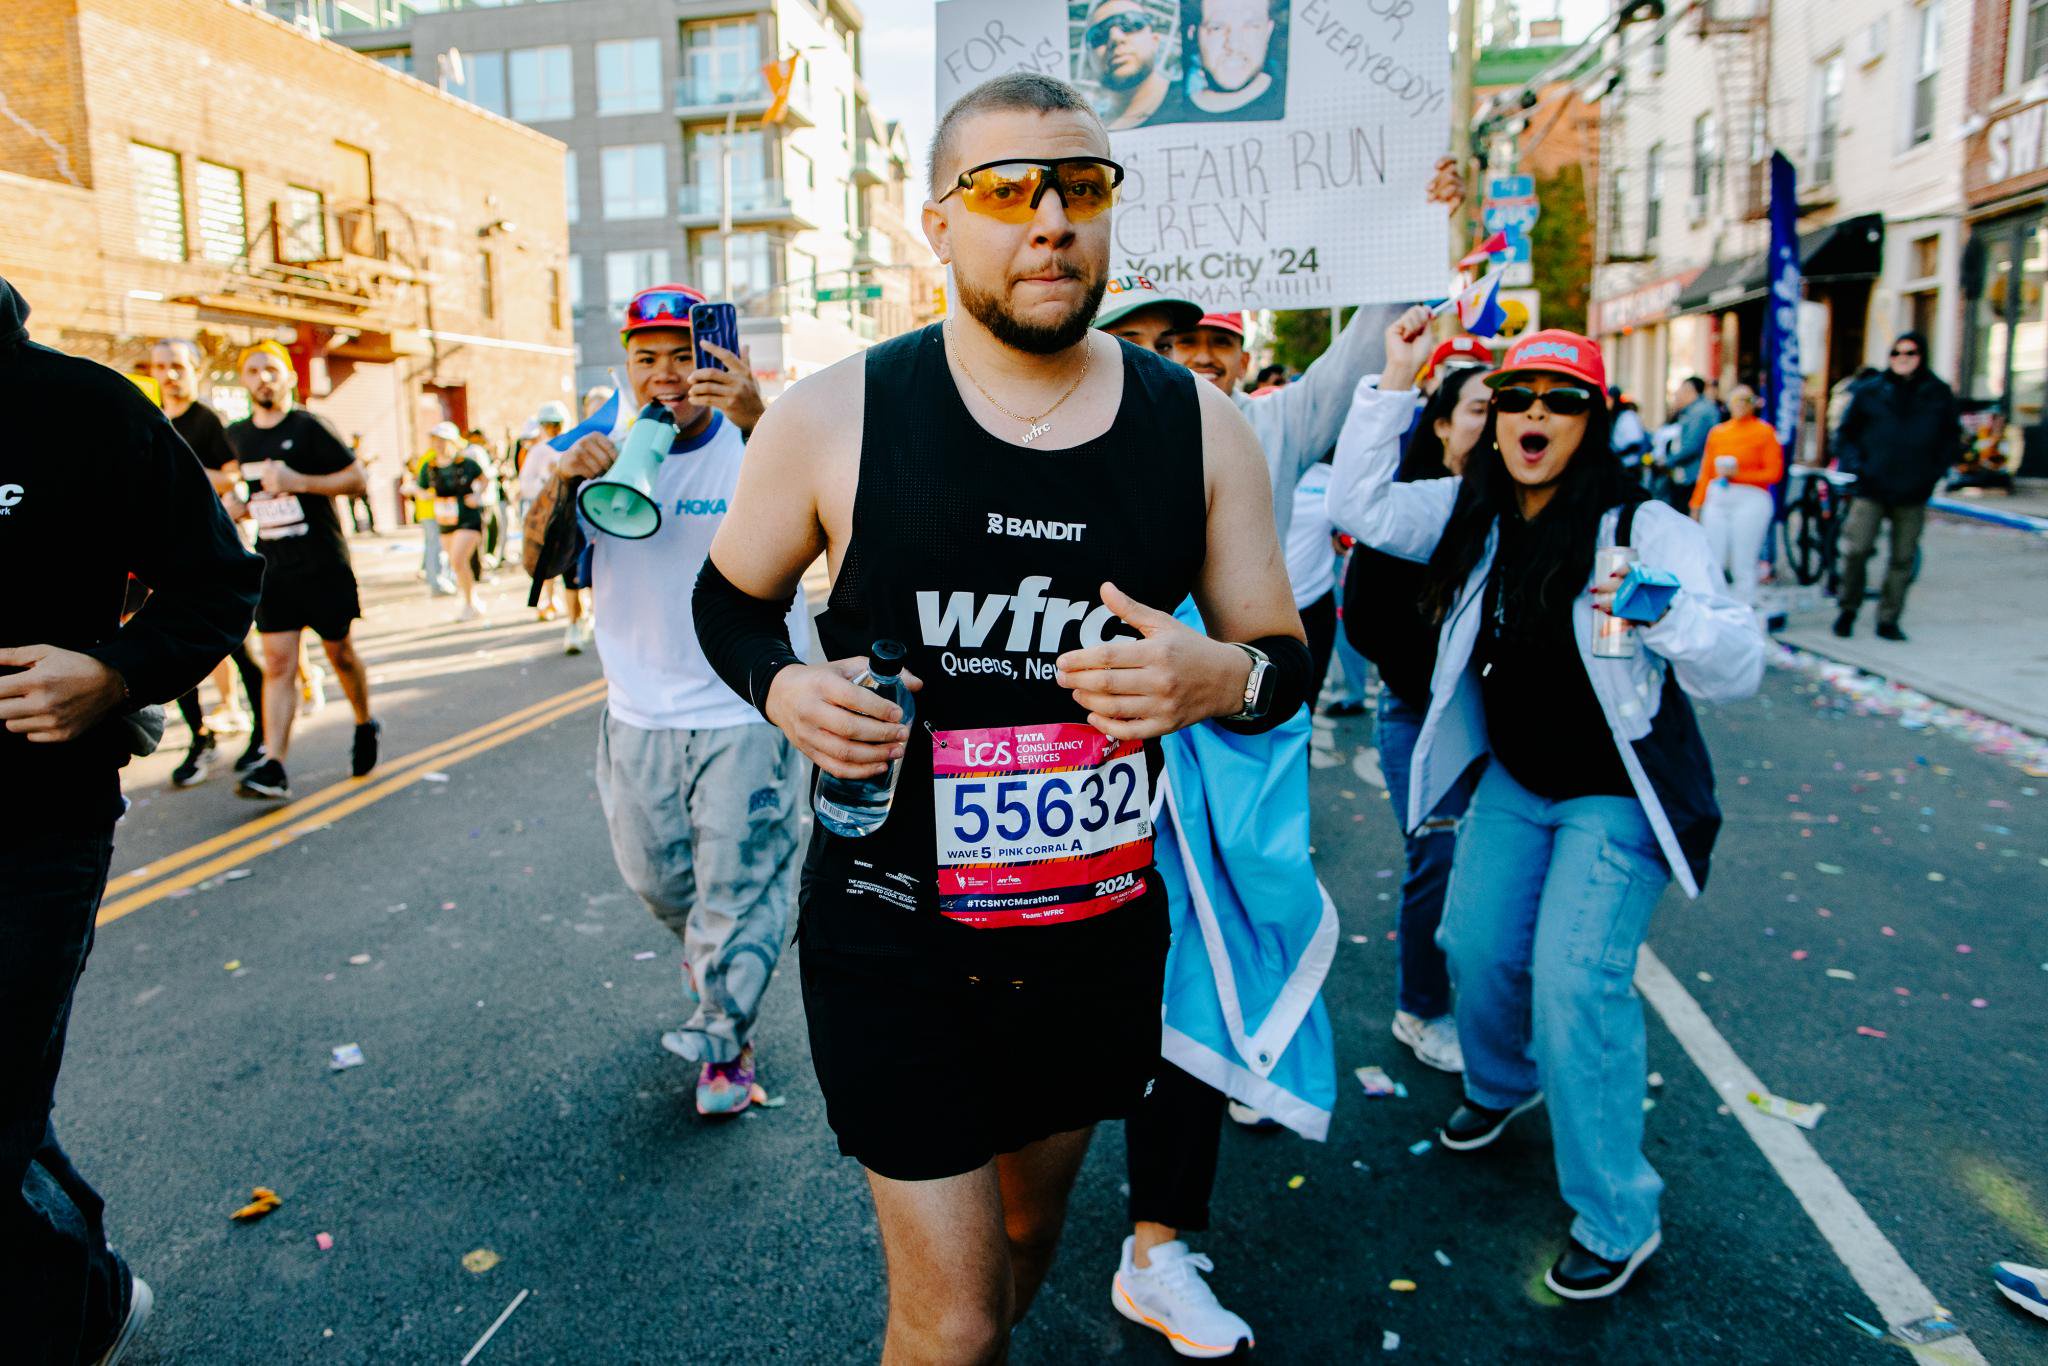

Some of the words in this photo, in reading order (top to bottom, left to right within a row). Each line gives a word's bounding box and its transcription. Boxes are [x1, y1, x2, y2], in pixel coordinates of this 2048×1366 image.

[944, 19, 1025, 84] FOR
[1157, 137, 1270, 202] FAIR
[1289, 125, 1386, 191] RUN
[1115, 199, 1269, 256] CREW
[1126, 255, 1195, 282] York
[1200, 250, 1263, 284] City
[1513, 341, 1579, 365] HOKA
[1022, 422, 1051, 443] wfrc
[675, 498, 727, 515] HOKA
[1006, 517, 1087, 541] BANDIT
[916, 575, 1138, 653] wfrc
[941, 651, 1018, 680] Queens,
[1015, 732, 1045, 742] TATA
[1016, 739, 1084, 754] CONSULTANCY
[963, 737, 1012, 766] tcs
[1016, 752, 1061, 764] SERVICES
[953, 762, 1141, 843] 55632
[947, 849, 979, 859] WAVE
[980, 846, 992, 859] 5
[998, 847, 1024, 857] PINK
[1025, 843, 1068, 855] CORRAL
[1069, 838, 1084, 851] A
[1095, 872, 1135, 897] 2024
[966, 894, 1060, 908] #TCSNYCMarathon
[1021, 912, 1042, 920] Team:
[1043, 908, 1064, 917] WFRC
